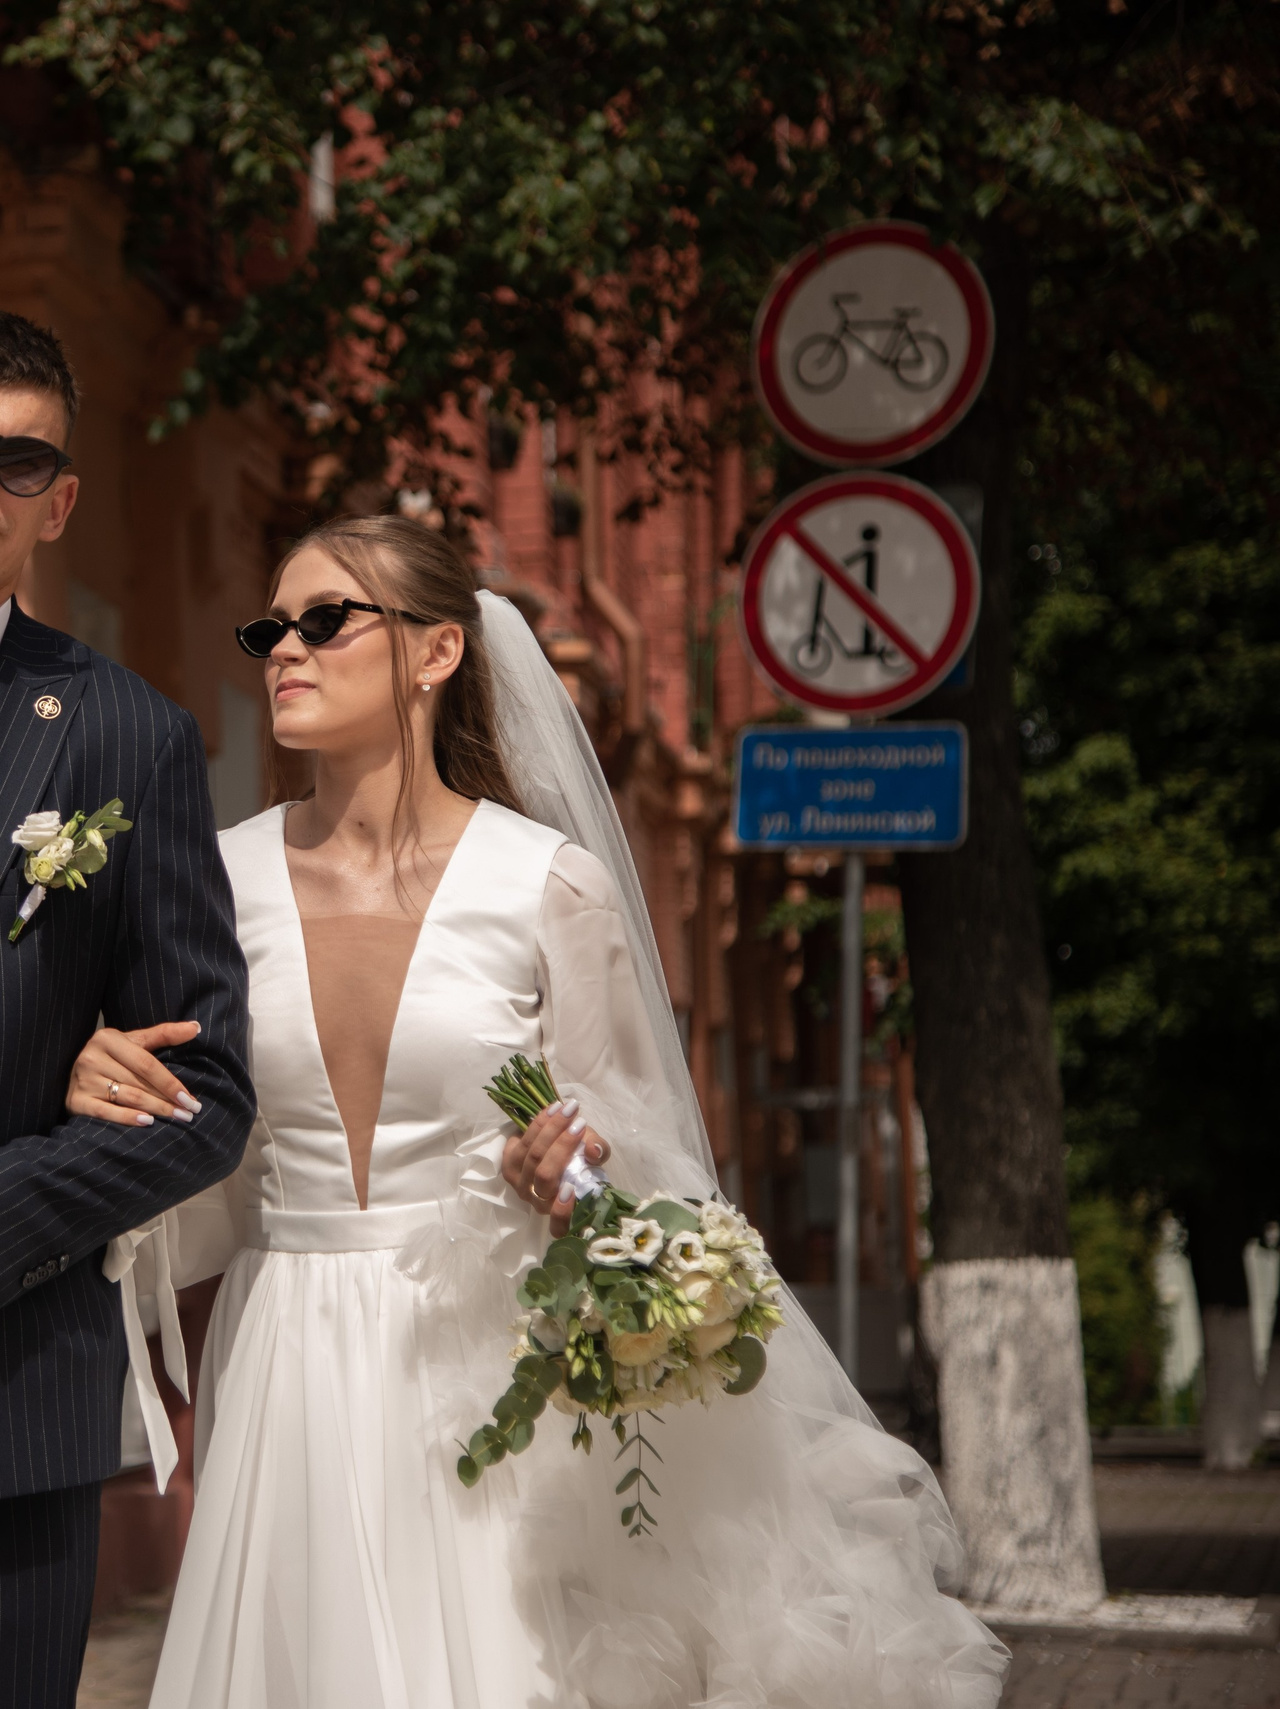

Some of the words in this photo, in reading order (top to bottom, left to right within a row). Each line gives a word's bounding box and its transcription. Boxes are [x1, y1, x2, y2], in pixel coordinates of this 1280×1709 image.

[753, 742, 789, 770] По
[820, 778, 876, 801] зоне
[801, 805, 937, 833] Ленинской
